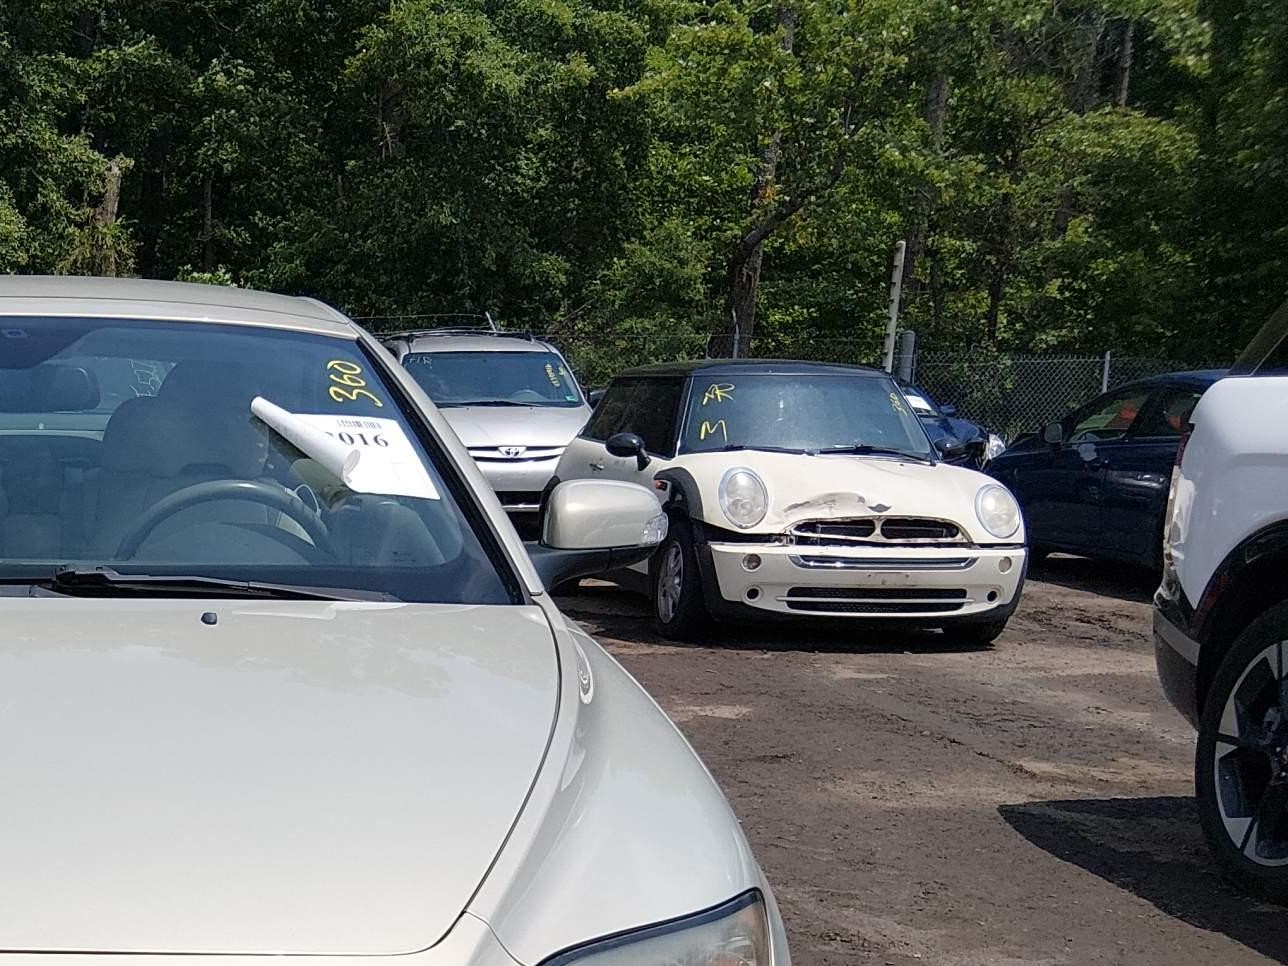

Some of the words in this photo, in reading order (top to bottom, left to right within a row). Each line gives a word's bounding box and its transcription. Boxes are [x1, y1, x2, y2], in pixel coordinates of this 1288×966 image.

[327, 360, 383, 407] 360
[702, 383, 736, 405] AR
[325, 431, 390, 448] 016
[700, 419, 727, 443] M
